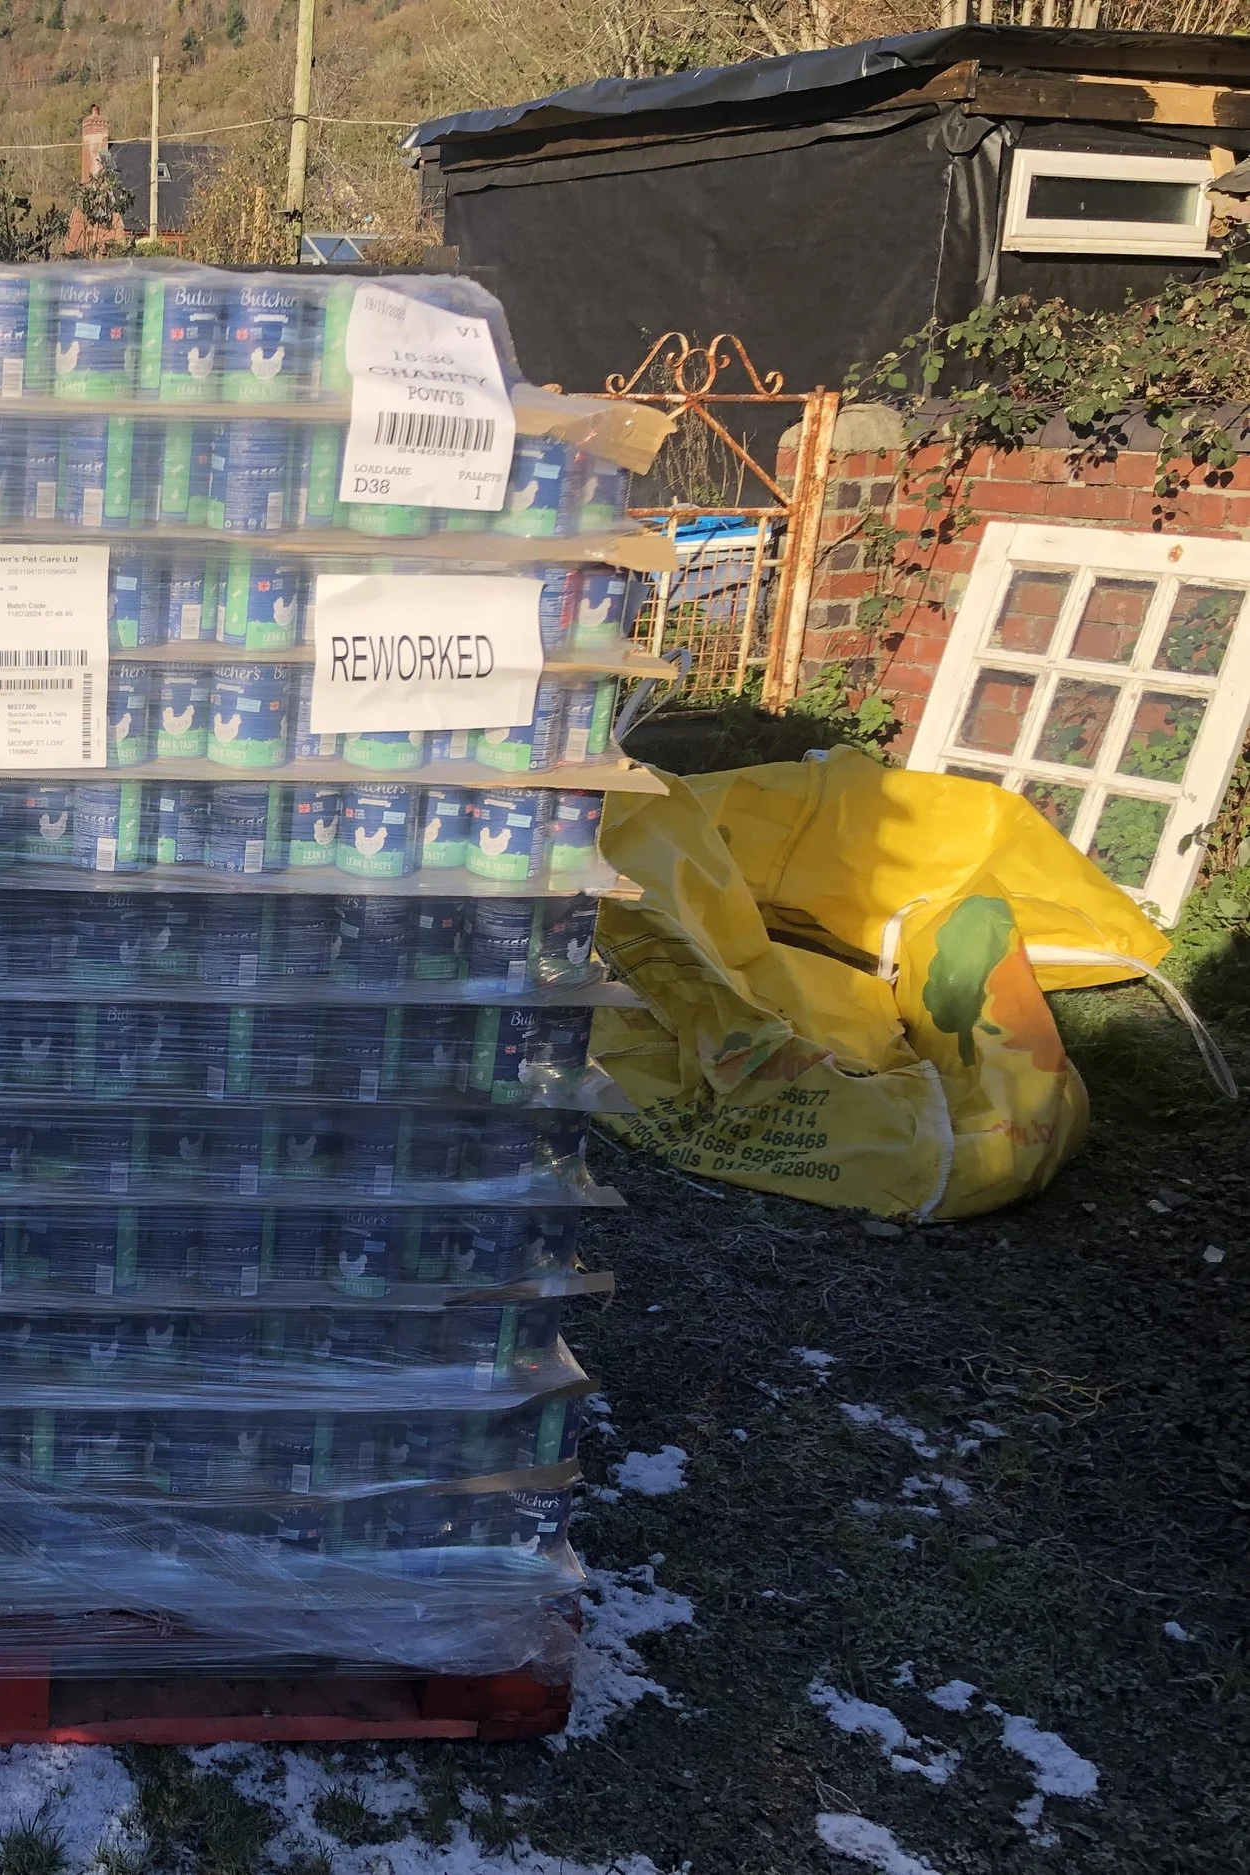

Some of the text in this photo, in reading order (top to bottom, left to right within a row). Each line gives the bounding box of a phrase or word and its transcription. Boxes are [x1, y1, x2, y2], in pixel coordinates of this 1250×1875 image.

[455, 326, 480, 338] V1
[368, 366, 487, 386] CHARITY
[407, 386, 464, 405] POWYS
[353, 464, 412, 476] LOAD LANE
[458, 471, 502, 482] PALLETS
[353, 478, 390, 494] D38
[474, 485, 481, 500] 1
[22, 555, 37, 563] Pet
[39, 555, 61, 563] Care
[63, 555, 78, 563] Ltd
[330, 635, 494, 681] REWORKED
[225, 750, 246, 760] TASTY
[346, 857, 361, 868] LEAN
[370, 860, 392, 871] TASTY
[761, 1128, 828, 1149] 468468
